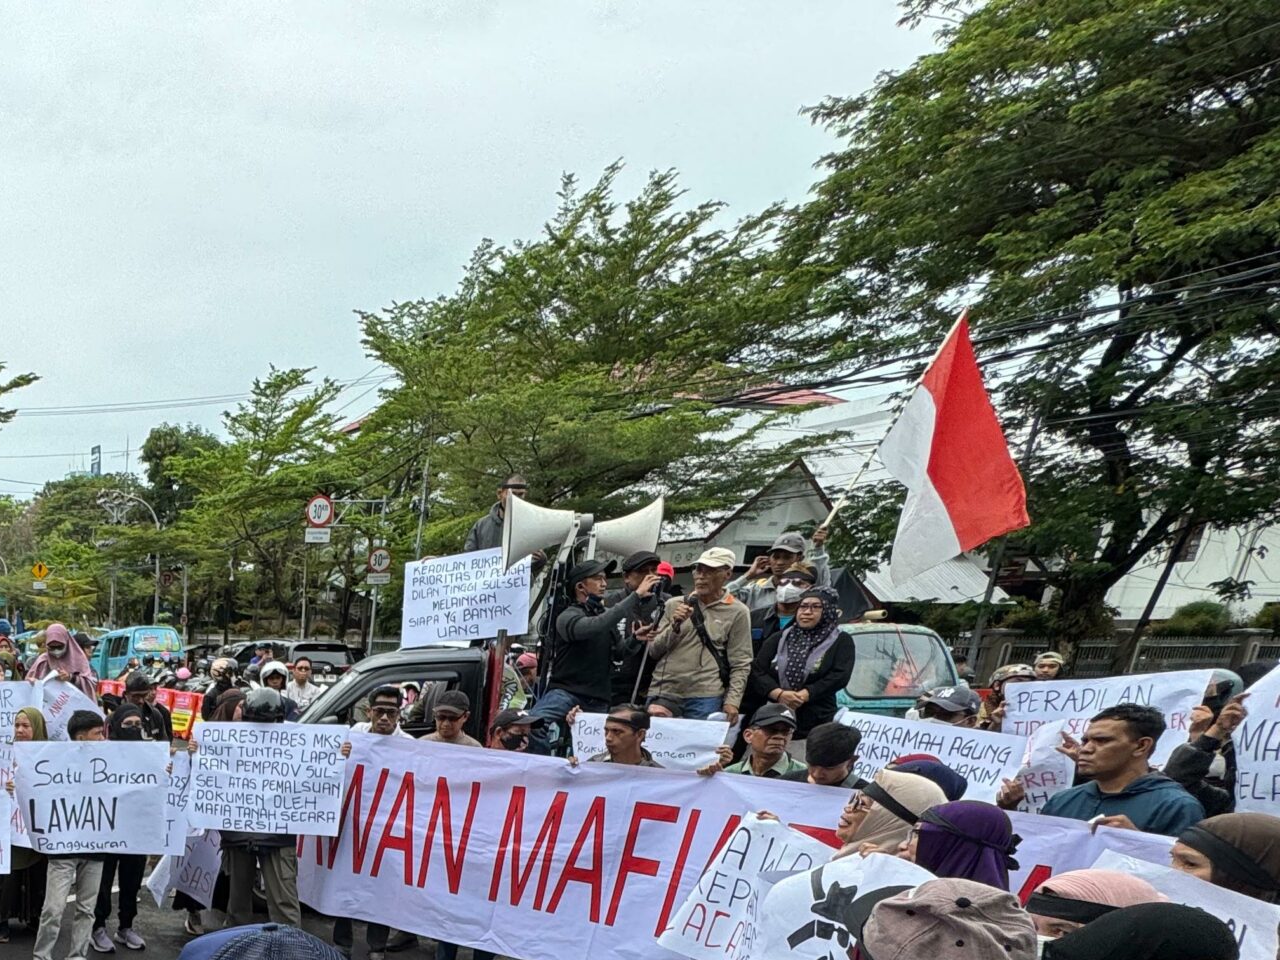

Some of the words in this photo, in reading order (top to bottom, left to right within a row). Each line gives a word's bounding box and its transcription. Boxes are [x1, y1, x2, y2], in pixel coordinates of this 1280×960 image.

[313, 504, 322, 519] 30
[373, 554, 383, 567] 30
[413, 560, 466, 577] KEADILAN
[412, 570, 471, 587] PRIORITAS
[475, 569, 486, 580] DI
[412, 587, 439, 601] DILAN
[442, 582, 477, 595] TINGGI
[481, 576, 527, 590] SUL-SEL
[432, 592, 497, 612] MELAINKAN
[408, 614, 440, 628] SIAPA
[444, 611, 456, 625] YG
[463, 604, 513, 623] BANYAK
[437, 624, 480, 639] UANG
[578, 719, 601, 736] Pak
[202, 728, 306, 747] POLRESTABES
[313, 733, 341, 749] MKS
[849, 719, 945, 754] MAHKAMAH
[948, 736, 1012, 766] AGUNG
[199, 745, 235, 757] USUT
[237, 745, 293, 760] TUNTAS
[301, 749, 345, 765] LAPO-
[33, 759, 82, 787] Satu
[90, 758, 157, 784] Barisan
[199, 757, 229, 771] RAN
[236, 759, 301, 777] PEMPROV
[306, 765, 339, 778] SUL-
[196, 775, 223, 789] SEL
[228, 777, 257, 790] ATAS
[262, 779, 340, 799] PEMALSUAN
[196, 789, 265, 809] DOKUMEN
[273, 794, 317, 810] OLEH
[29, 796, 118, 834] LAWAN
[195, 802, 231, 817] MAFIA
[235, 806, 276, 821] TANAH
[280, 811, 336, 823] SECARA
[222, 818, 288, 834] BERSIH
[37, 837, 128, 851] Penggusuran
